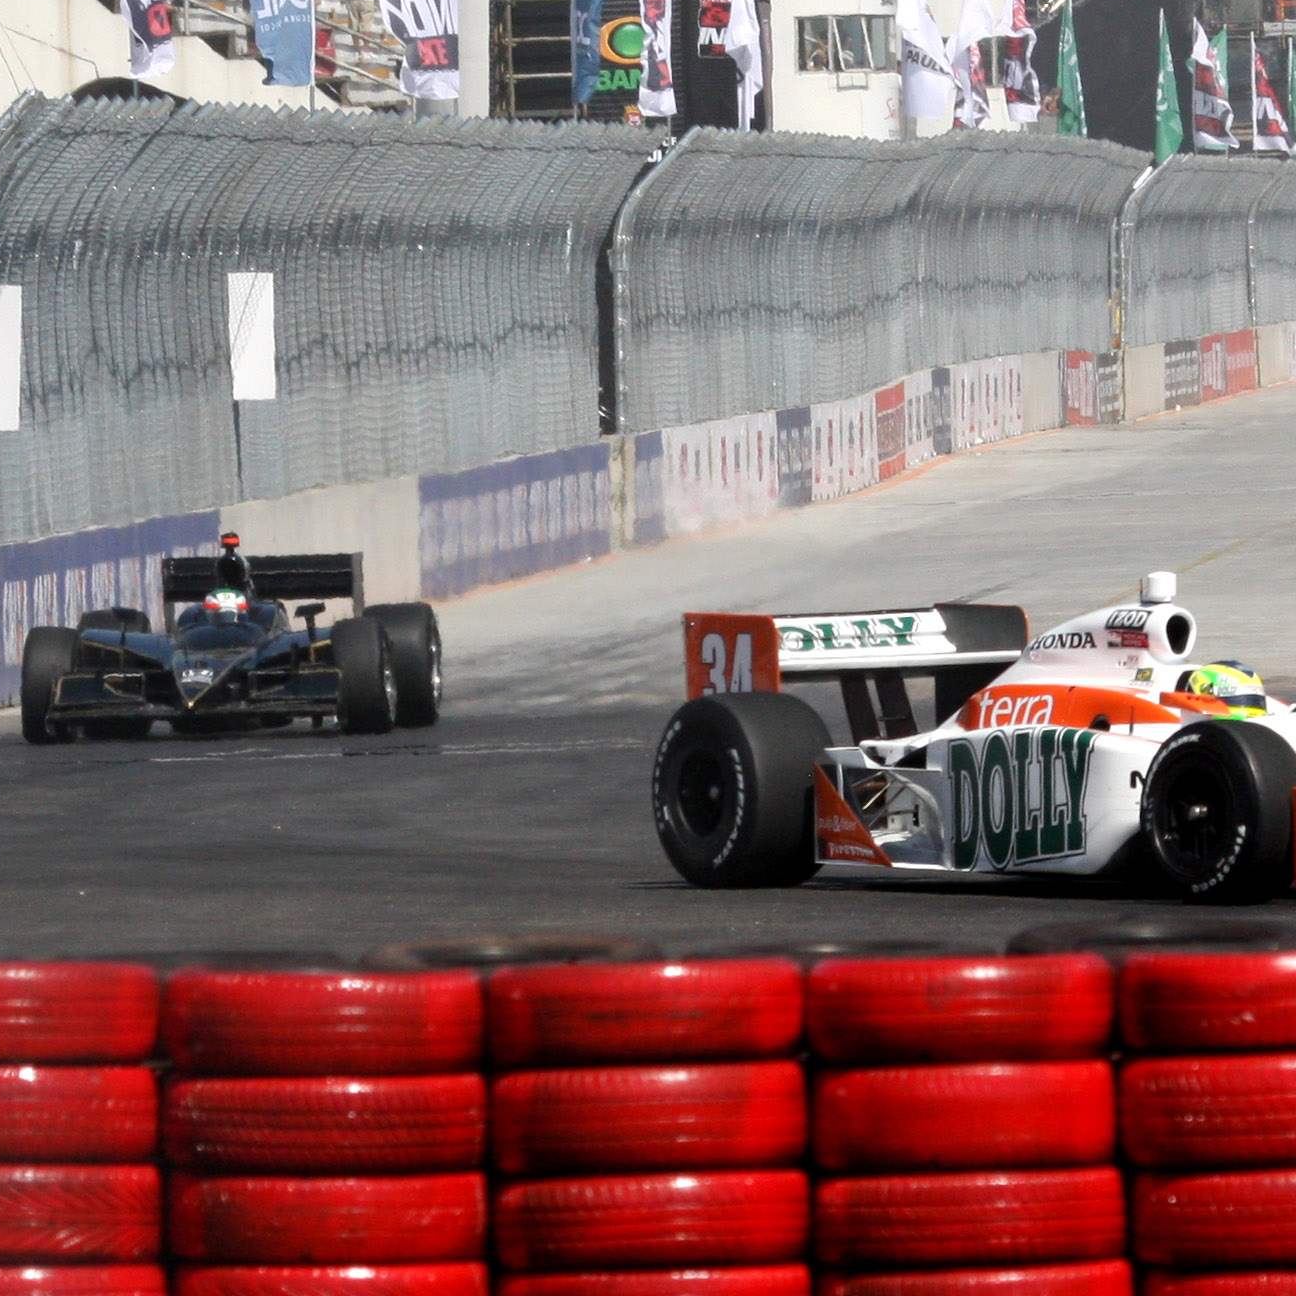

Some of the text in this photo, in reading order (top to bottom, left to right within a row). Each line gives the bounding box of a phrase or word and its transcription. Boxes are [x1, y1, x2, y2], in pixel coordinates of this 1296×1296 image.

[779, 615, 919, 652] OLLY
[1107, 611, 1148, 628] IZOD
[1030, 632, 1097, 651] HONDA
[702, 632, 753, 693] 34
[979, 690, 1054, 728] terra
[948, 726, 1101, 871] DOLLY
